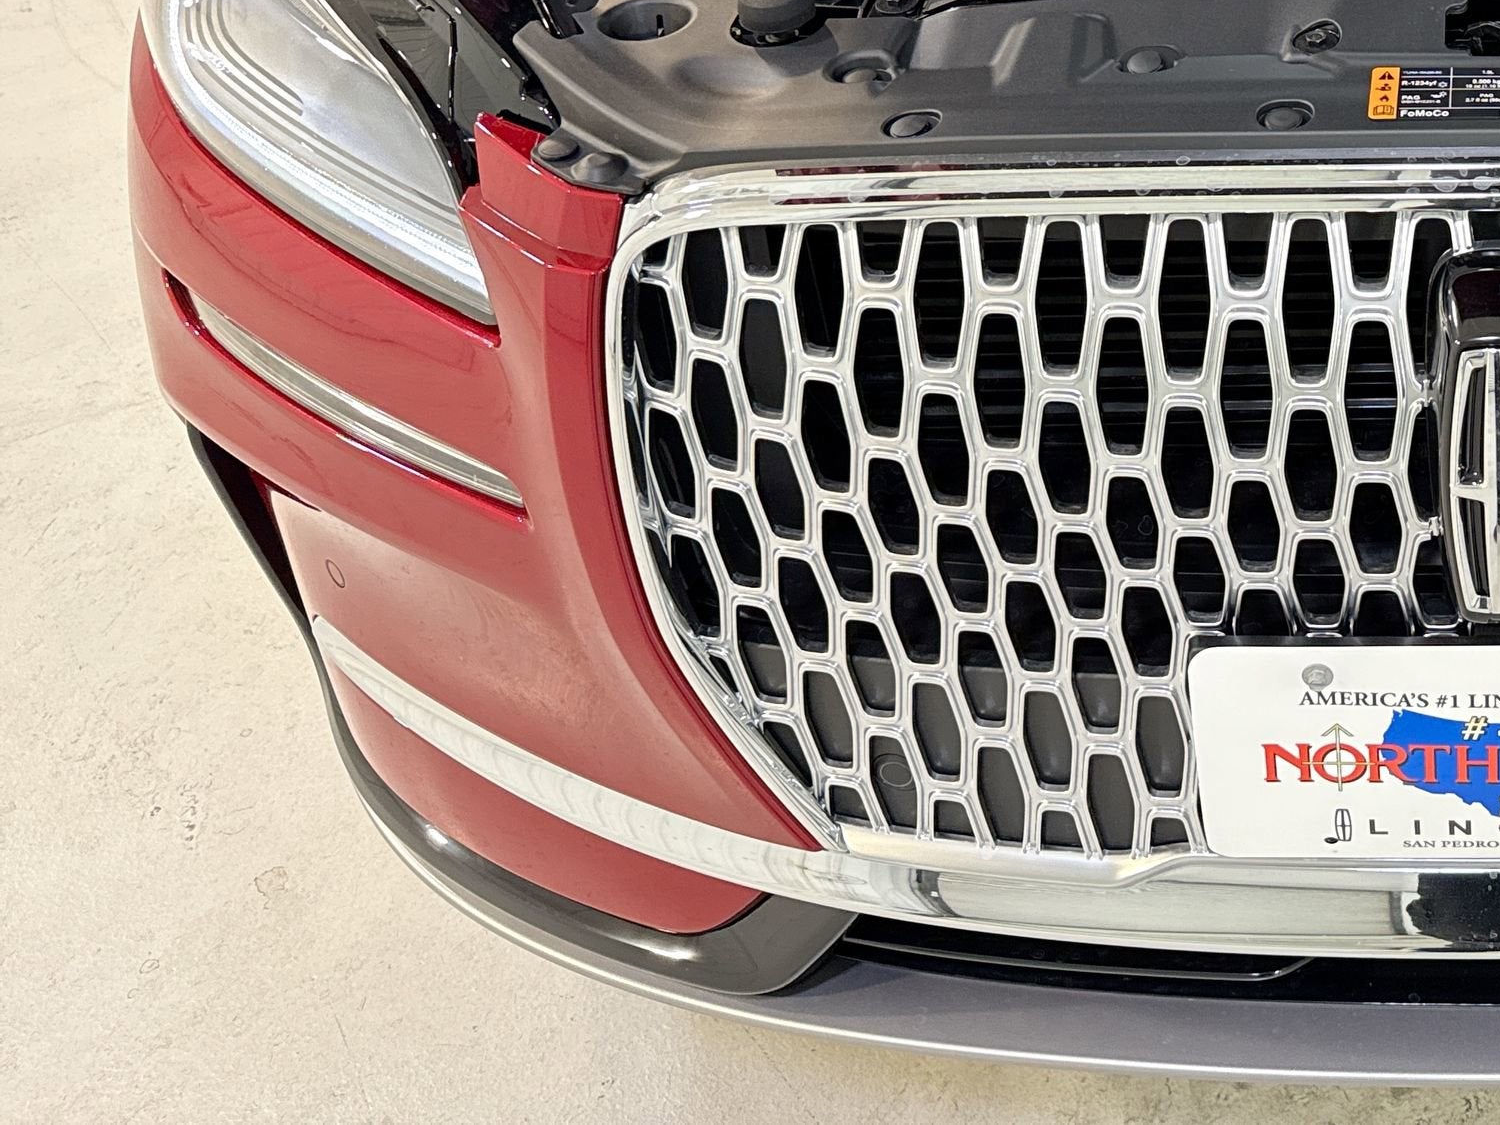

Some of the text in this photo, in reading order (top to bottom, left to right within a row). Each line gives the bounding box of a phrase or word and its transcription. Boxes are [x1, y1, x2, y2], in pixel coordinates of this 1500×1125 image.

[1401, 80, 1438, 88] R-1234yf
[1400, 109, 1450, 117] FoMoCo
[1299, 690, 1430, 709] AMERICA'S
[1435, 693, 1460, 709] #1
[1261, 742, 1500, 785] NORTH
[1402, 839, 1436, 849] SAN
[1440, 839, 1500, 849] PEDRO
